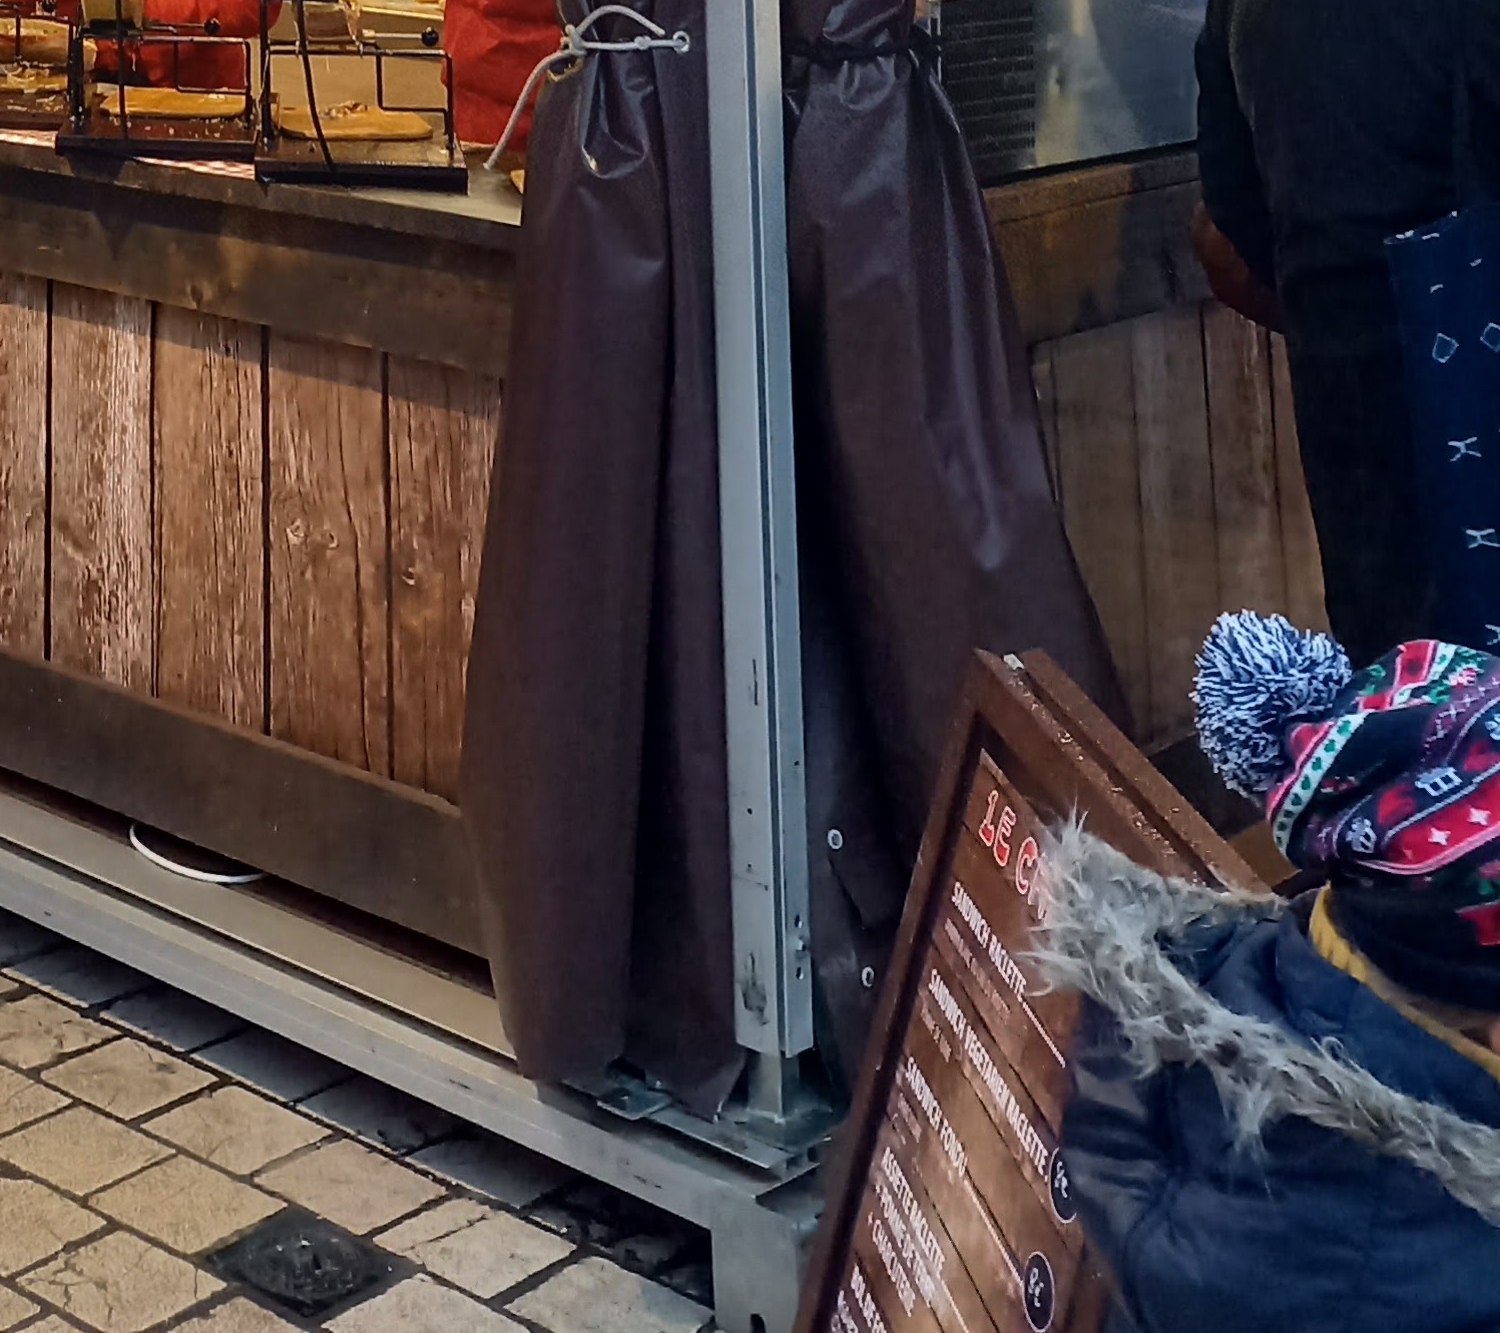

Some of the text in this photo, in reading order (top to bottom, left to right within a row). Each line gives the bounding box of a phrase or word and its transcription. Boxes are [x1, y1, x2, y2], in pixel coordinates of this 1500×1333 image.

[979, 790, 1016, 867] LE
[952, 882, 991, 949] SANDWICH
[988, 934, 1027, 1002] RACLETTE
[905, 1056, 943, 1131] SANDWICH
[940, 1118, 969, 1179] FONDU
[928, 968, 967, 1041] SANDWICH
[1006, 1095, 1049, 1177] RACLETTE
